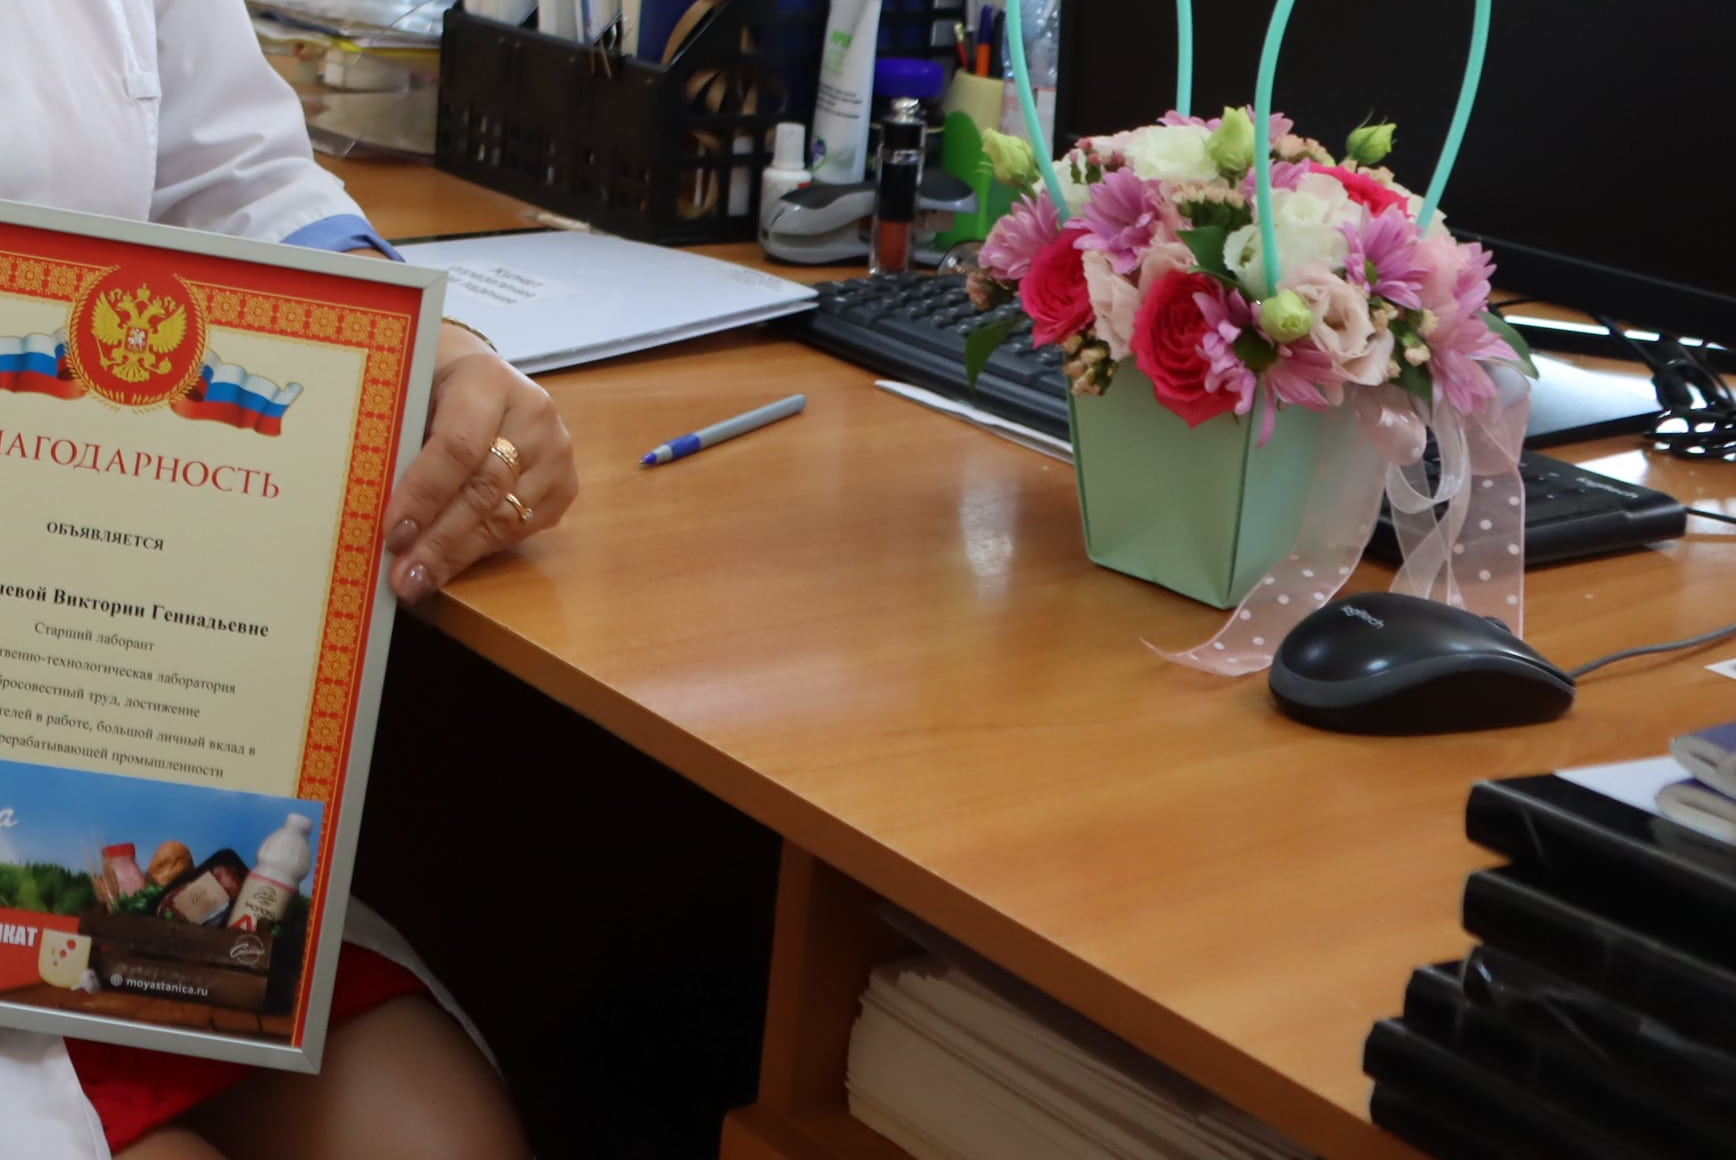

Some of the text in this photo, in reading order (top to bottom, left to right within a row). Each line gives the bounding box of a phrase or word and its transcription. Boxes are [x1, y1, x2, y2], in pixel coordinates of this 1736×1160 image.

[46, 521, 164, 551] ОБЪЯВЛЯЕТСЯ
[53, 588, 145, 618] Виктории
[152, 604, 270, 638] Геннадьевне
[34, 621, 155, 652] Старший лаборант
[157, 672, 236, 695] лаборатория
[89, 690, 121, 708] труд,
[124, 698, 201, 719] достижение
[36, 713, 44, 722] в
[46, 713, 93, 733] работе,
[96, 719, 154, 740] большой
[156, 731, 205, 749] личный
[209, 741, 246, 756] вклад
[248, 746, 257, 756] в
[111, 750, 224, 778] промышленности
[126, 978, 208, 997] moyastanica.ru
